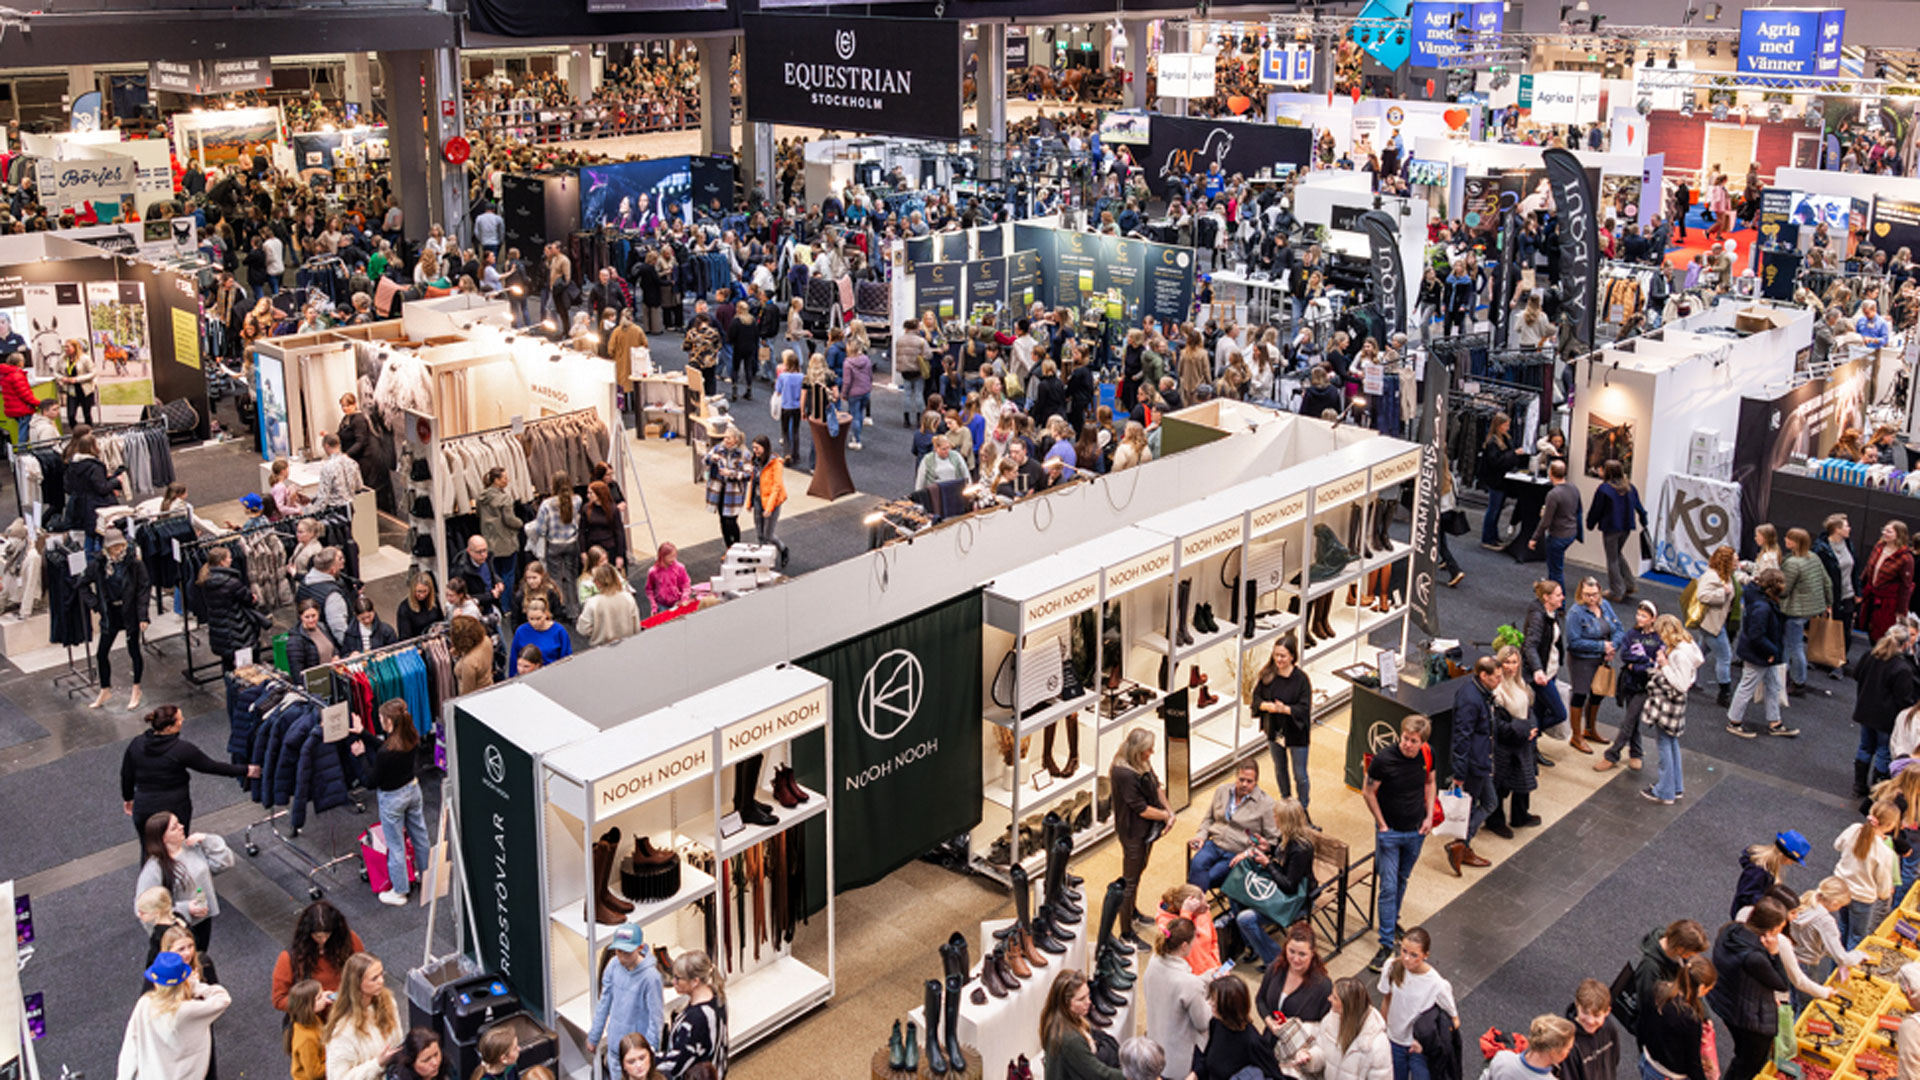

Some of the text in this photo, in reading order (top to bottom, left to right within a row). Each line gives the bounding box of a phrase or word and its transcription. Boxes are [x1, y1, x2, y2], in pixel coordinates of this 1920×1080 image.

[1424, 12, 1452, 27] Agri
[1756, 21, 1800, 39] Agria
[1760, 39, 1794, 53] med
[784, 62, 912, 95] EQUESTRIAN
[1748, 56, 1805, 71] Vänner
[811, 93, 883, 110] STOCKHOLM
[1537, 91, 1566, 104] Agria
[1374, 458, 1417, 482] NOOH NOOH
[1317, 479, 1365, 504] NOOH NOOH
[1416, 443, 1435, 554] FRAMTIDENS
[1253, 501, 1303, 528] NOOH NOOH
[1669, 489, 1729, 560] K9
[1184, 525, 1240, 555] NOOH NOOH
[1109, 554, 1171, 588] NOOH NOOH
[1029, 584, 1096, 620] NOOH NOOH
[728, 701, 820, 750] NOOH NOOH
[602, 750, 705, 805] NOOH NOOH
[845, 738, 938, 791] NOOH NOOH
[492, 812, 511, 977] RIDSTÖVLAR
